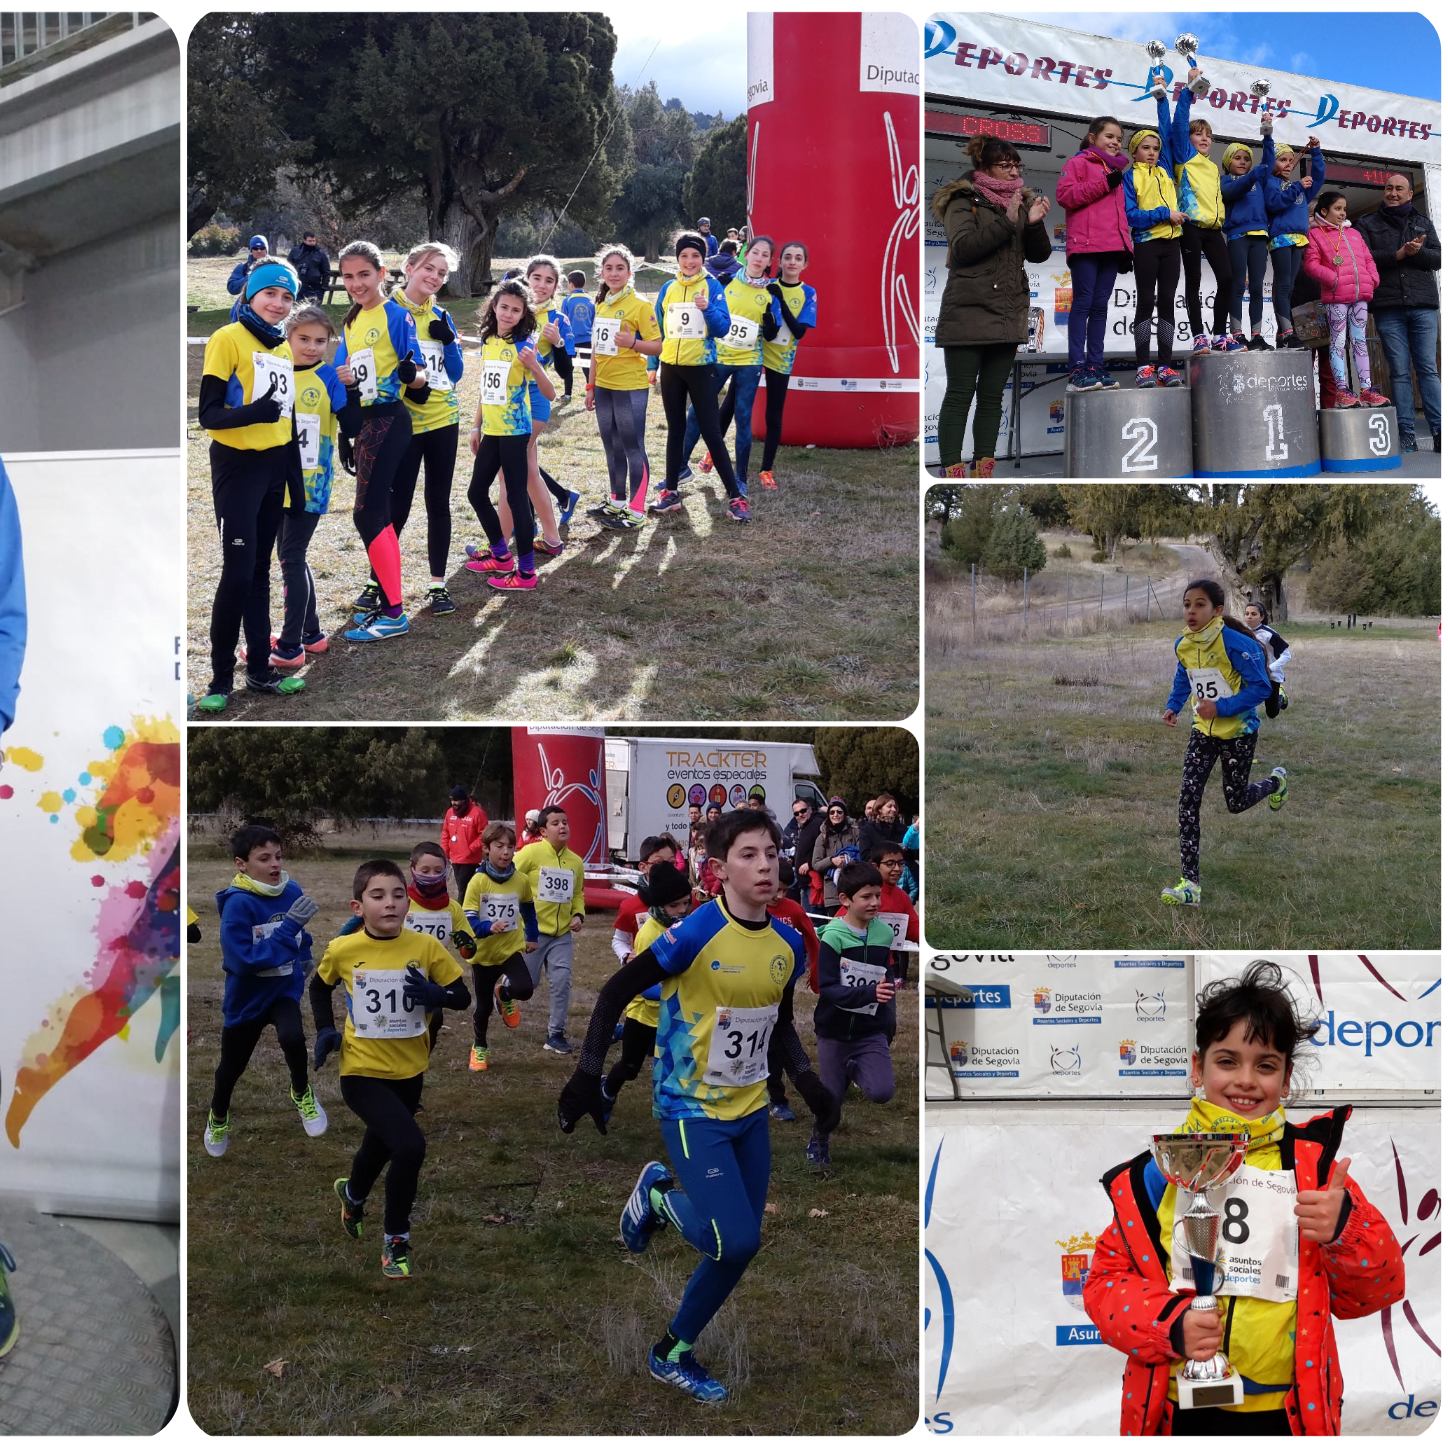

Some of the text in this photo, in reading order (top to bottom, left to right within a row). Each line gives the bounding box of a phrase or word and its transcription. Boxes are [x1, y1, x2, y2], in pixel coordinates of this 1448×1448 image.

[1306, 94, 1432, 140] DEPORTES
[963, 116, 1040, 142] CROSS
[681, 313, 689, 325] 9
[730, 324, 748, 339] 95
[270, 371, 287, 395] 93
[483, 373, 501, 388] 156
[1263, 404, 1288, 461] 1
[1369, 413, 1391, 456] 3
[1122, 418, 1158, 472] 2
[1196, 681, 1218, 698] 85
[666, 751, 767, 767] TRACKTER
[667, 769, 766, 780] eventos especiales
[672, 822, 687, 830] todo
[545, 877, 568, 891] 398
[487, 904, 515, 917] 375
[1055, 992, 1101, 1003] Diputación
[1055, 1003, 1103, 1013] de Segovia
[724, 1026, 769, 1059] 314
[971, 1047, 1019, 1056] Diputación
[1140, 1045, 1187, 1055] Diputación
[972, 1057, 1020, 1067] de Segovia
[1140, 1056, 1188, 1066] de Segovia
[1252, 1178, 1263, 1187] de
[1267, 1180, 1296, 1194] Segovia
[1222, 1197, 1250, 1244] 8
[1229, 1257, 1262, 1265] asuntos
[1229, 1264, 1261, 1275] sociales
[1224, 1273, 1261, 1284] deportes
